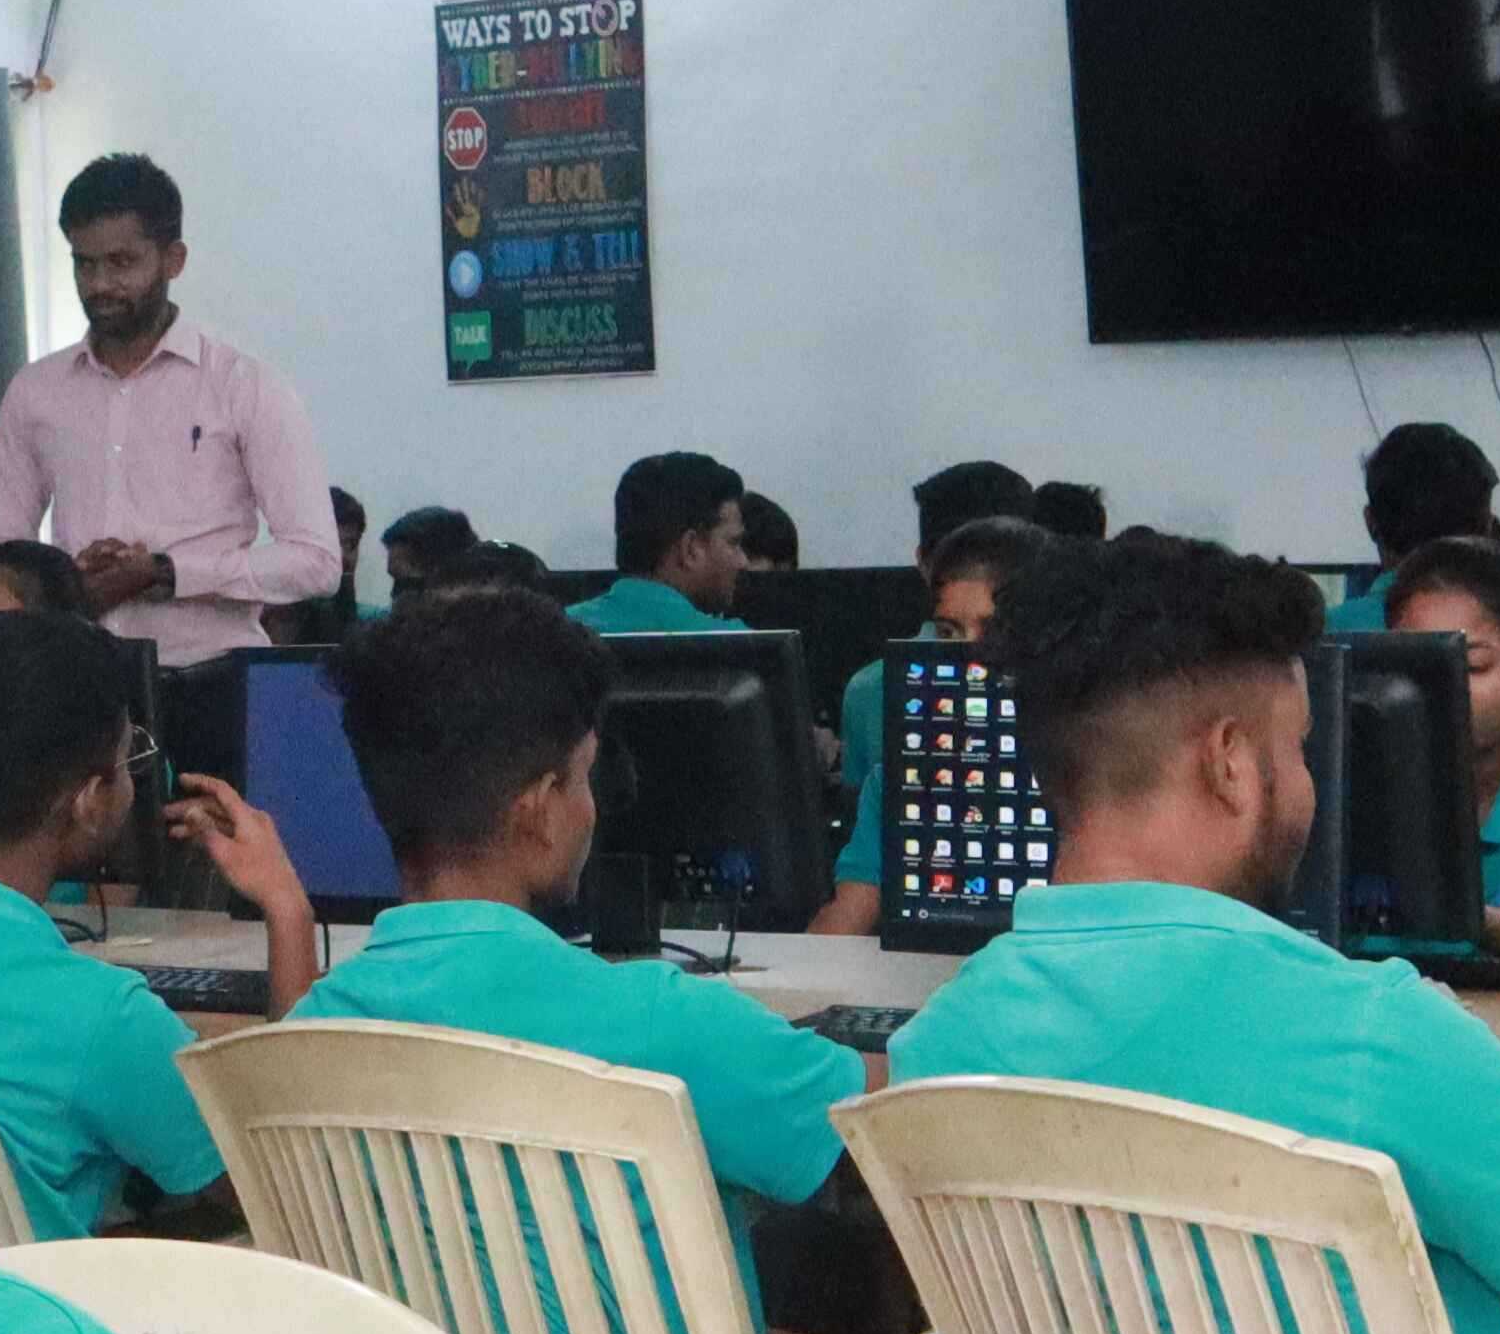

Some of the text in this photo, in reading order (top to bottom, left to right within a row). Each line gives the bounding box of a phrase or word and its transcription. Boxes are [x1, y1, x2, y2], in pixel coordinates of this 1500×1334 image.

[442, 16, 511, 48] WAYS
[519, 9, 552, 42] TO
[447, 128, 483, 152] STOP
[527, 164, 607, 204] BLOCK
